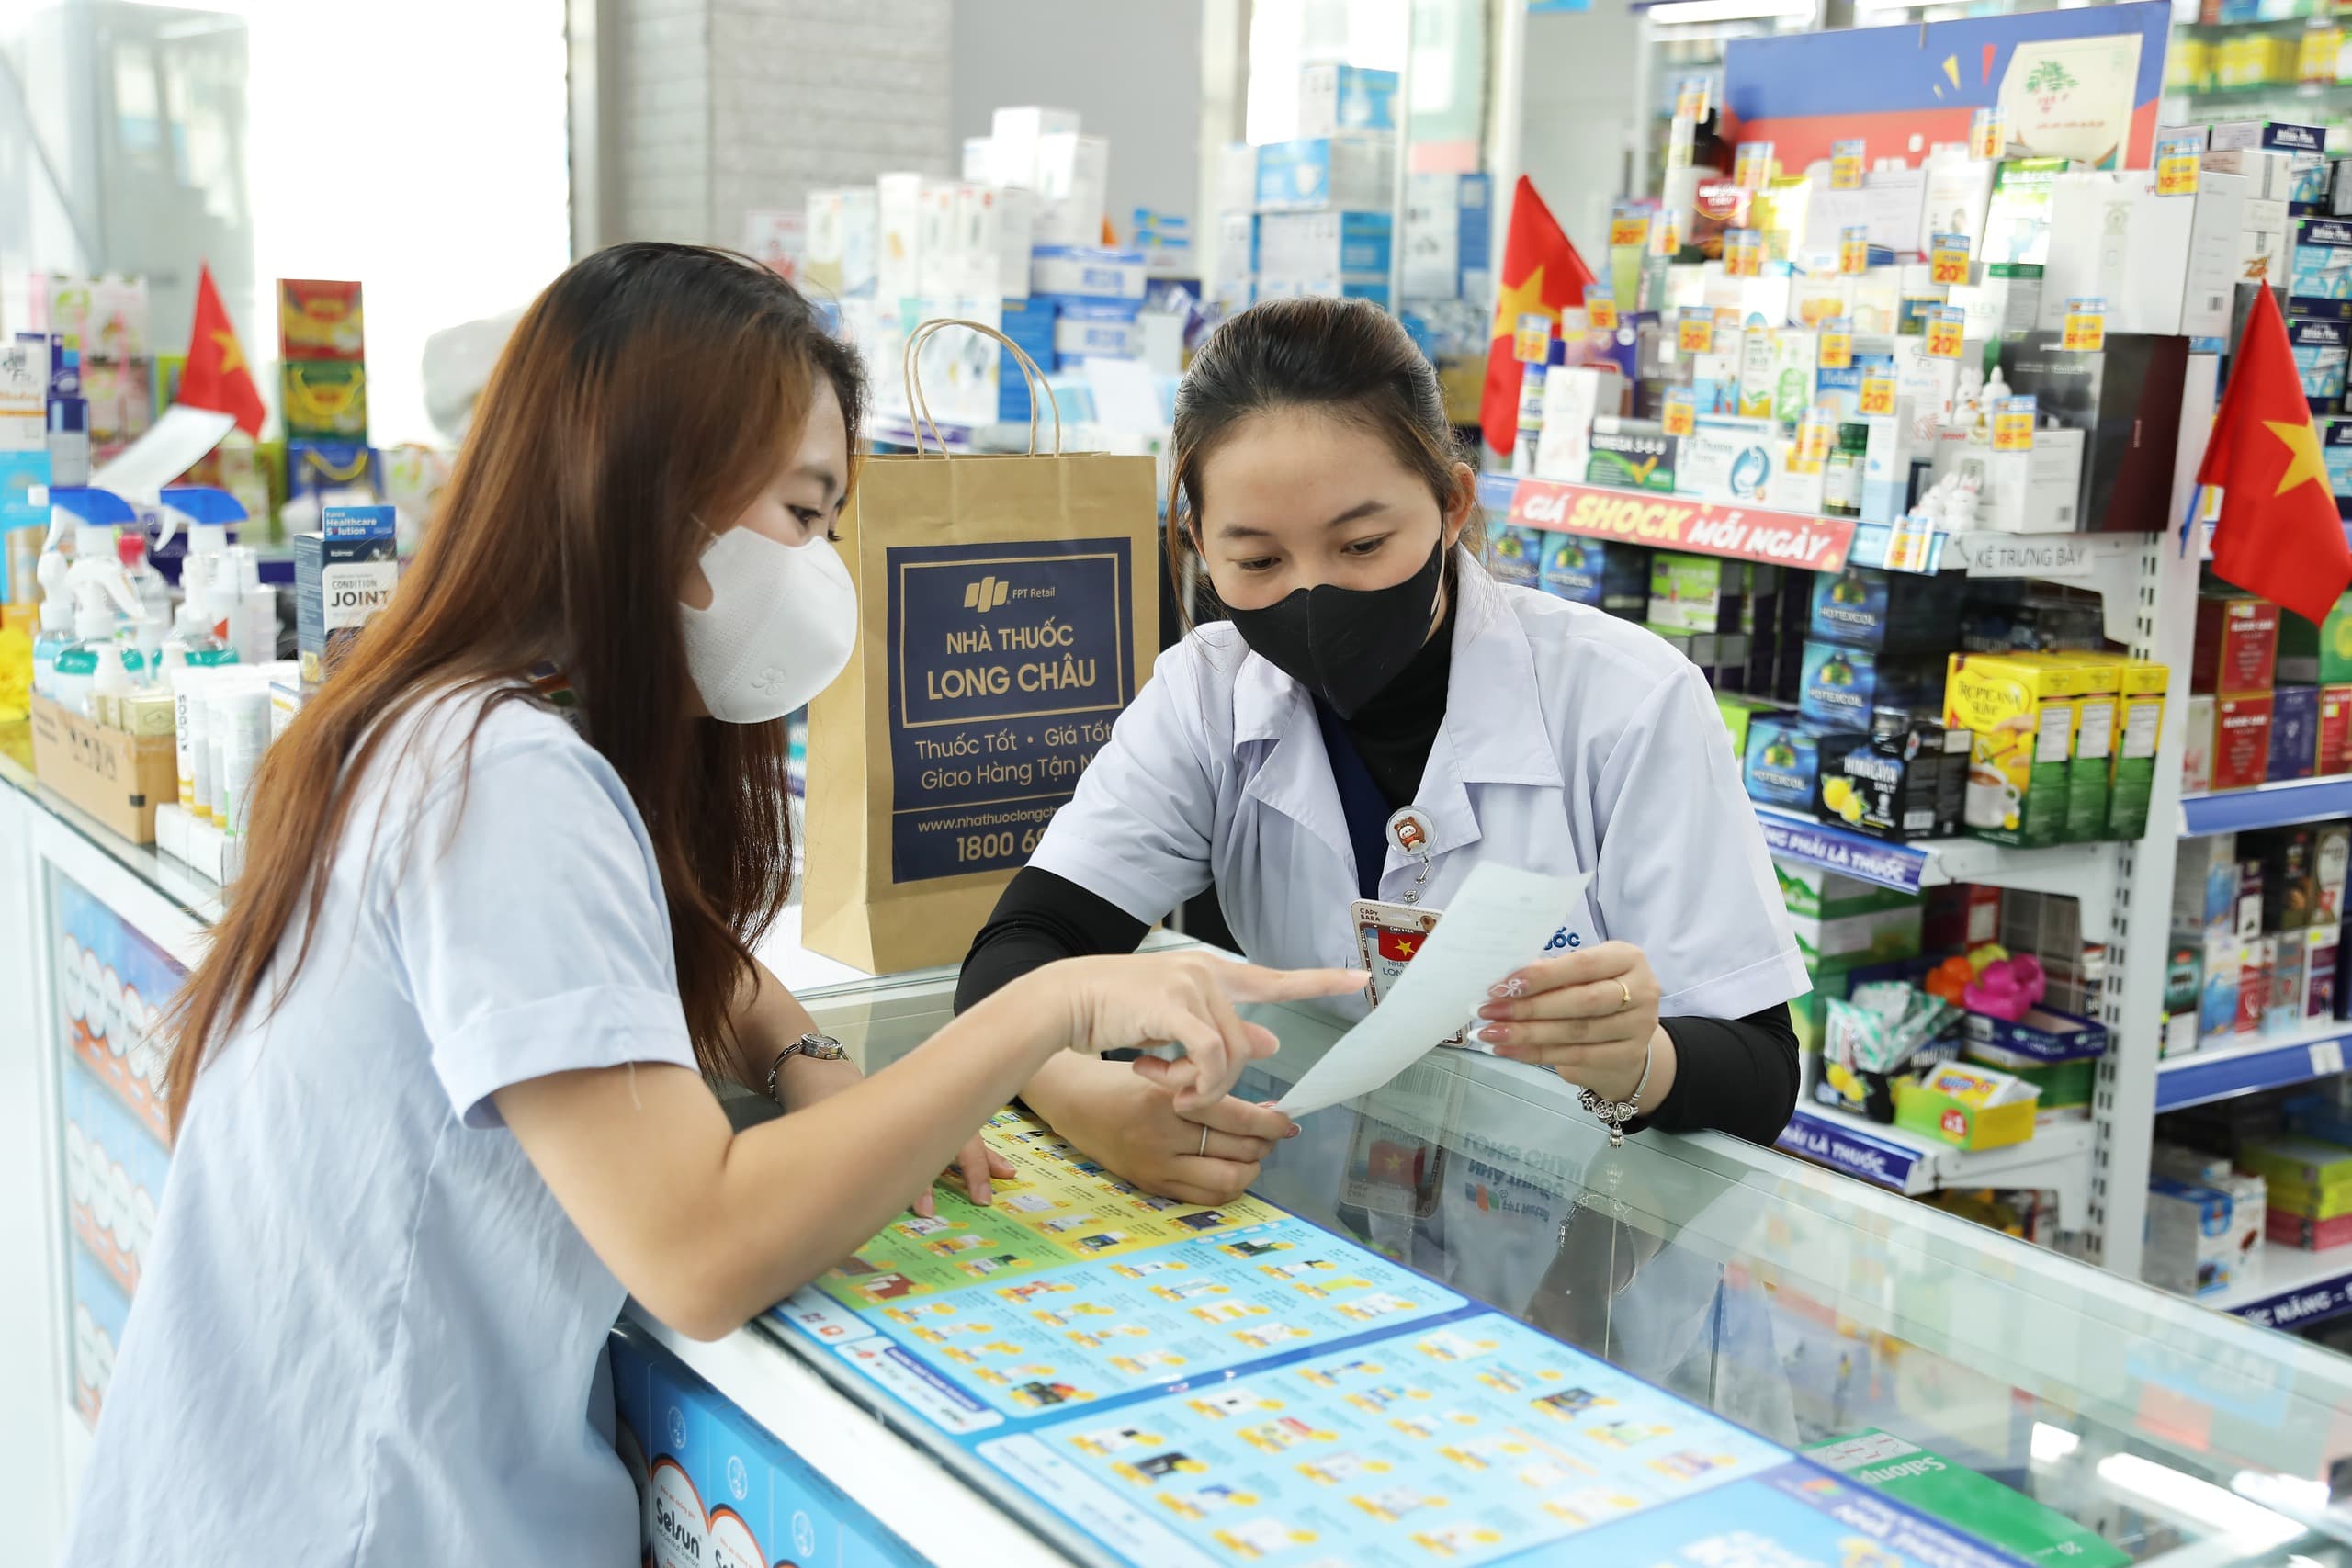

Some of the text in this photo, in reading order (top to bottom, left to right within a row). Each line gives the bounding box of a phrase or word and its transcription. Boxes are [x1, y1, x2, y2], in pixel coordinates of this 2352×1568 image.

[326, 518, 378, 527] Healthcare
[1521, 493, 1832, 562] GIÁ SHOCK MỖI NGÀY
[331, 590, 390, 607] JOINT
[332, 580, 378, 590] CONDITION
[1012, 586, 1056, 599] FPT Retail
[946, 616, 1074, 654] NHÀ THUỐC
[927, 653, 1096, 700] LONG CHÂU
[915, 733, 979, 761] Thuốc
[984, 728, 1017, 751] Tốt
[1045, 724, 1078, 747] Giá
[921, 767, 971, 790] Giao
[977, 761, 1032, 785] Hàng
[1037, 756, 1075, 782] Tận
[1844, 755, 1898, 784] HIMALAYA
[918, 806, 1058, 833] www.nhathuoclongch
[957, 832, 1013, 863] 1800
[1788, 832, 1827, 858] PHẢI
[1826, 844, 1850, 866] LÀ
[1850, 851, 1907, 883] THUỐC
[1807, 1133, 1830, 1155] LÀ
[1831, 1142, 1888, 1176] THUỐC
[2272, 1291, 2333, 1325] NĂNG
[656, 1496, 700, 1560] Selsun
